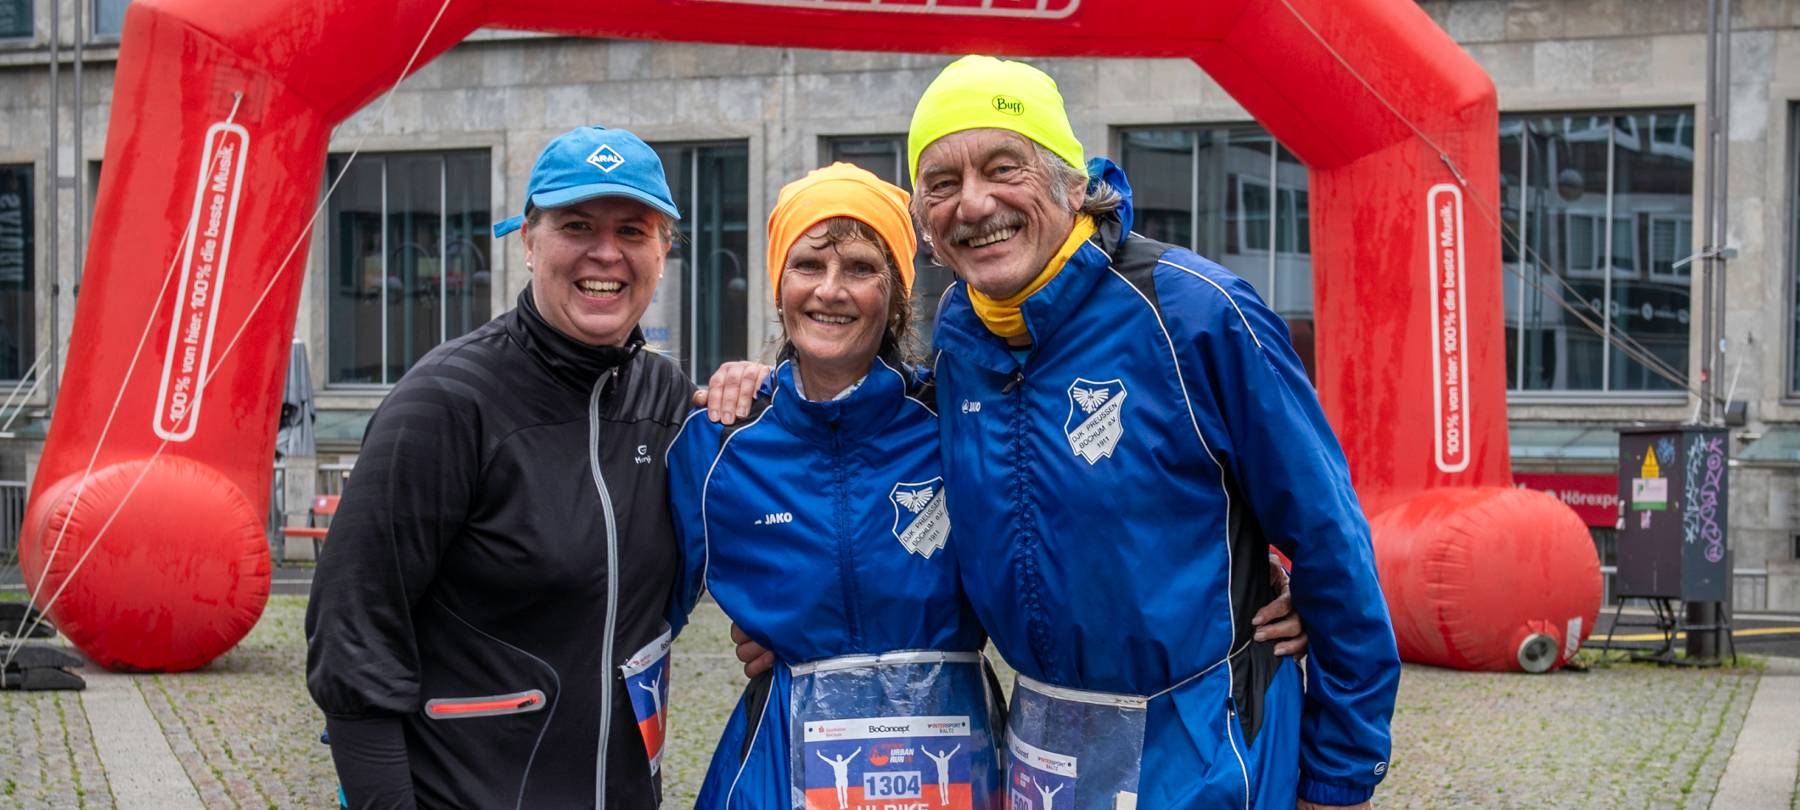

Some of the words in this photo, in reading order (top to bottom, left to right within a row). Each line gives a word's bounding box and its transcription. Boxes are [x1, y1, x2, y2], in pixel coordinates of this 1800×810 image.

[996, 97, 1021, 113] Buff
[212, 142, 235, 193] Musik.
[591, 153, 619, 163] ARAL
[203, 194, 225, 238] beste
[1440, 200, 1454, 248] Musik.
[200, 239, 216, 262] die
[1443, 248, 1455, 288] beste
[191, 263, 212, 310] 100%
[1443, 289, 1456, 311] die
[183, 312, 203, 344] hier.
[1443, 311, 1457, 355] 100%
[181, 346, 196, 373] von
[1445, 355, 1458, 385] hier.
[169, 376, 191, 423] 100%
[1448, 386, 1459, 412] von
[1071, 431, 1085, 443] DJK
[1086, 402, 1118, 431] PREUSSEN
[1446, 413, 1460, 456] 100%
[1079, 424, 1106, 449] BOCHUM
[1097, 435, 1110, 449] 1911
[765, 512, 793, 525] JAKO
[902, 529, 915, 543] DJK
[914, 497, 942, 529] PREUSSEN
[912, 520, 935, 547] BOCHUM
[928, 529, 940, 542] 1911
[868, 724, 910, 734] BoConcept
[890, 748, 915, 756] URBAN
[866, 775, 920, 796] 1304
